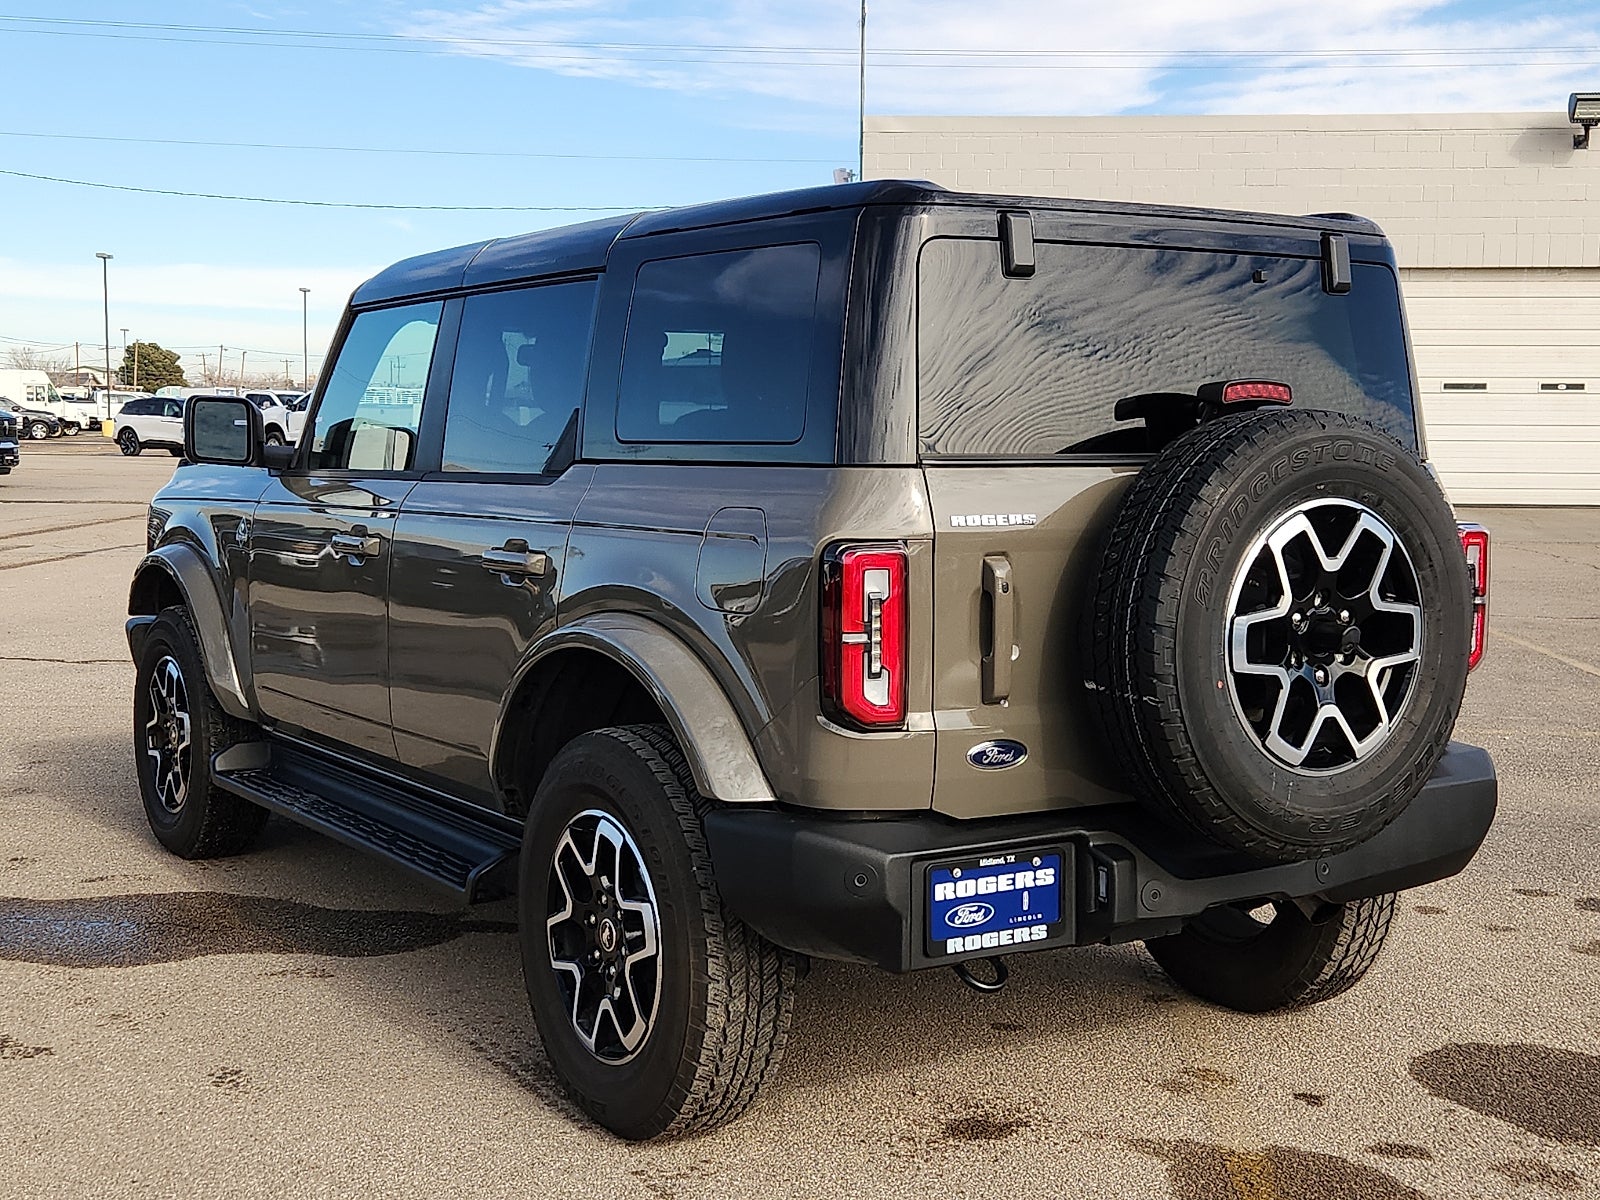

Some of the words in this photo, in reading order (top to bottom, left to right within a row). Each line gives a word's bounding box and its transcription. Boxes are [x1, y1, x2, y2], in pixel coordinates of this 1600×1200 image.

[950, 513, 1036, 527] ROGERS
[934, 867, 1056, 902] ROGERS
[954, 906, 985, 925] Ford
[1008, 913, 1043, 924] LINCOLN
[946, 924, 1048, 954] ROGERS
